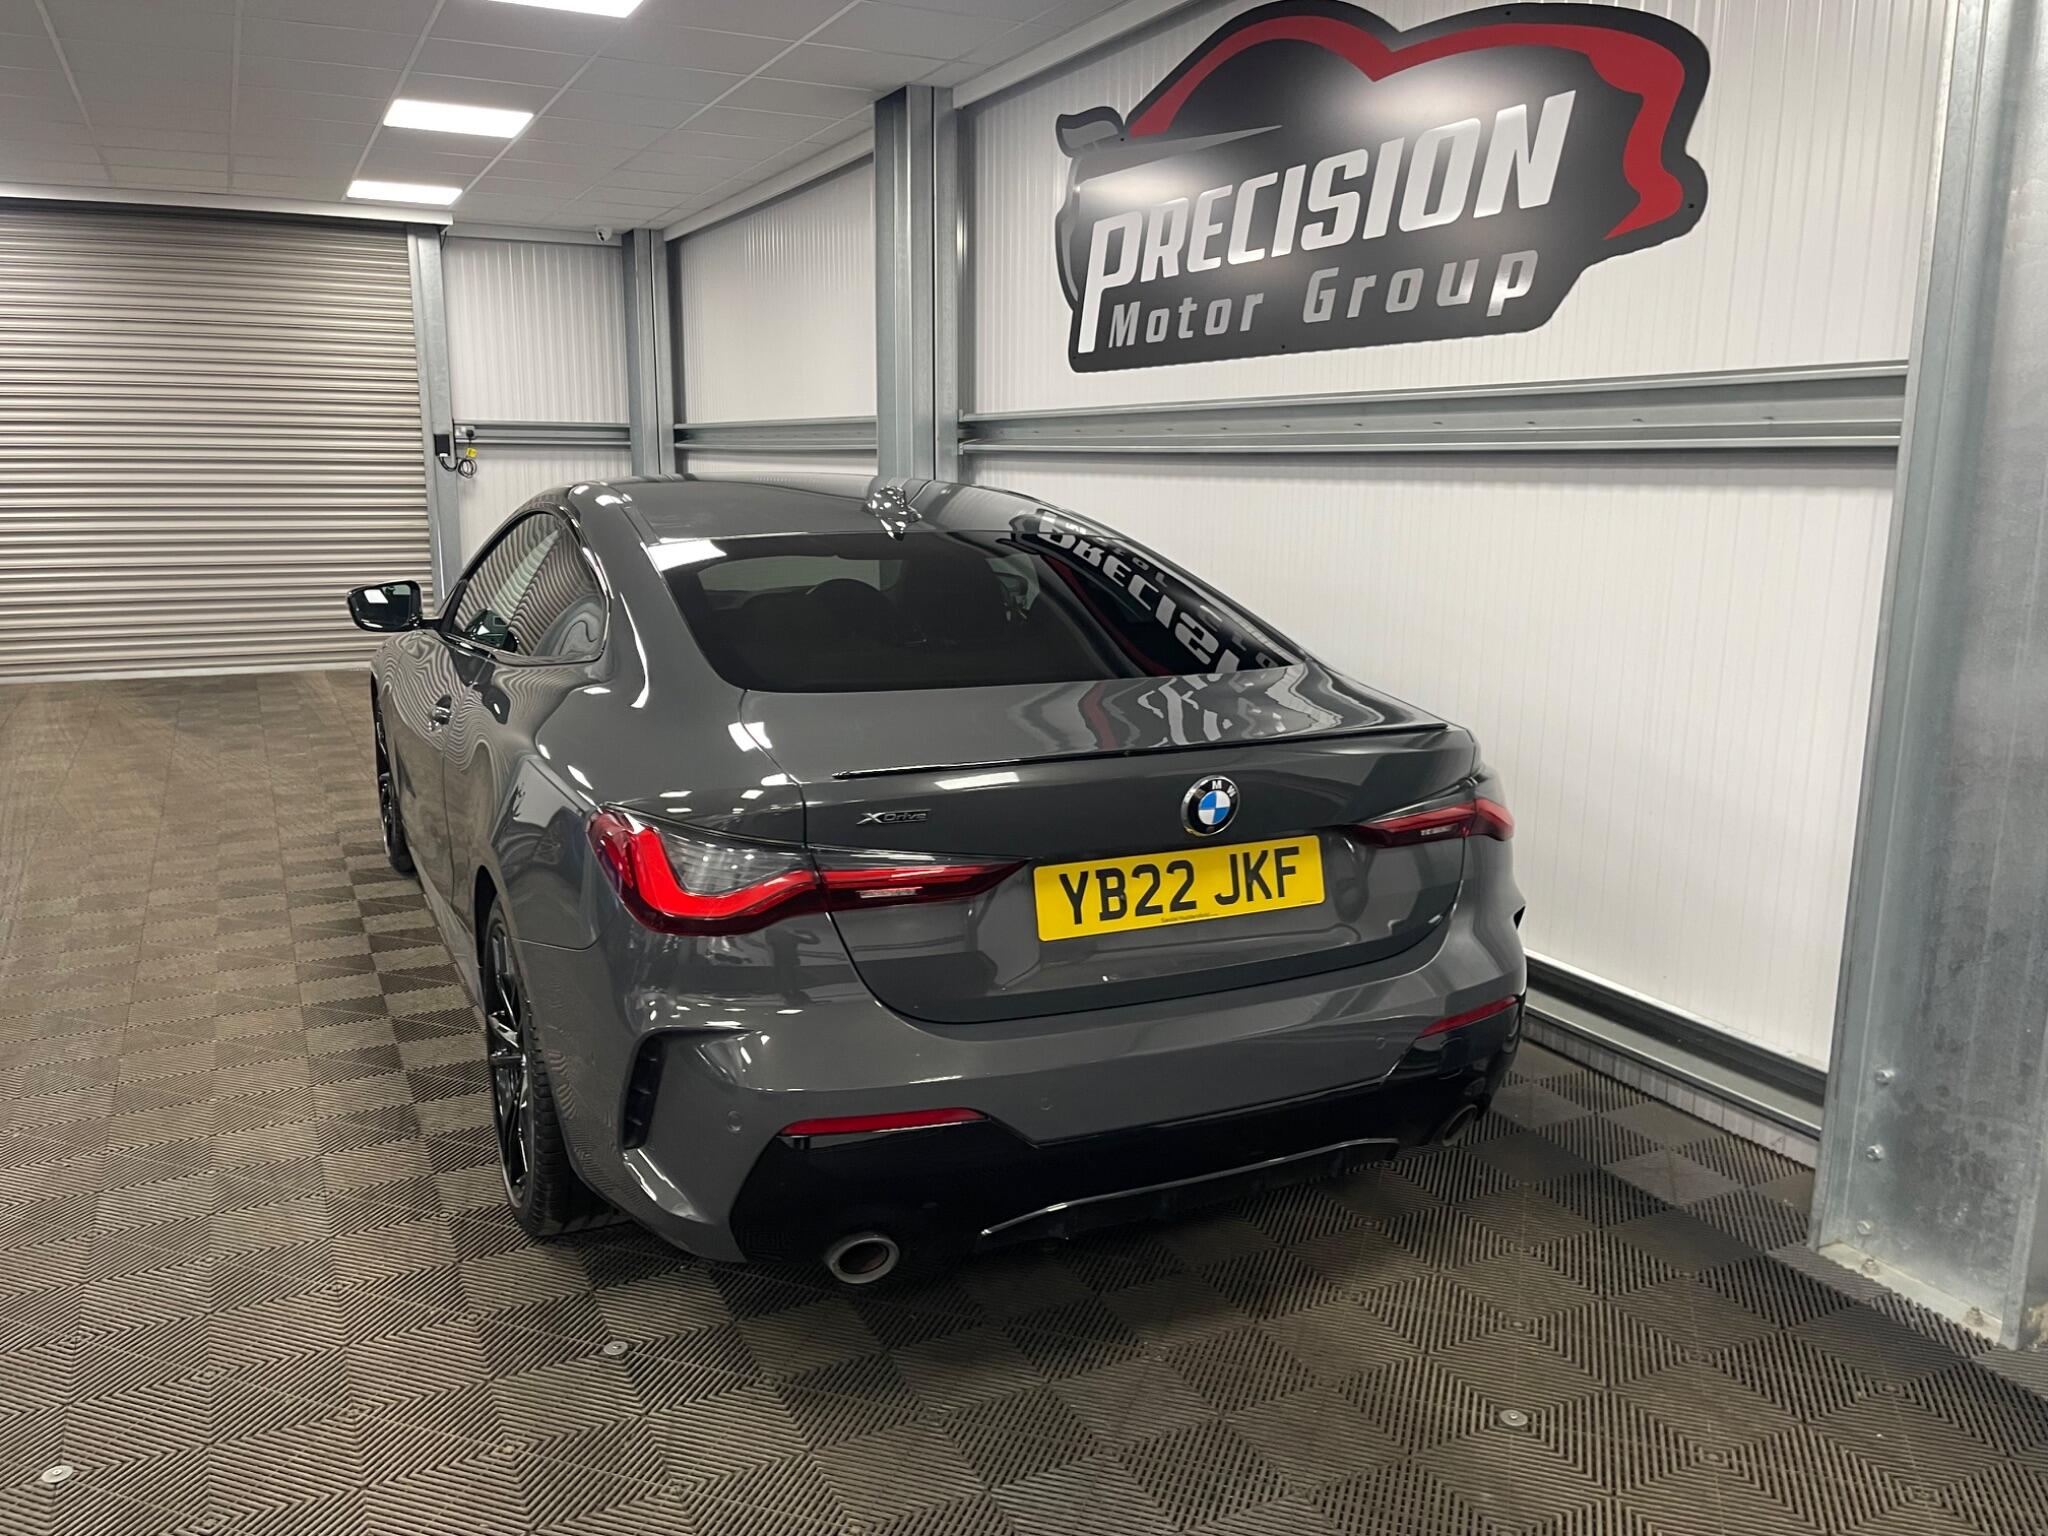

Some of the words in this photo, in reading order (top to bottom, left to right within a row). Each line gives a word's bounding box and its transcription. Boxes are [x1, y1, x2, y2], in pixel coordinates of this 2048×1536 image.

[1077, 90, 1576, 353] PRECISION
[1108, 291, 1264, 349] Motor
[1301, 250, 1540, 323] Group
[1058, 859, 1197, 926] YB22
[1213, 846, 1300, 906] JKF
